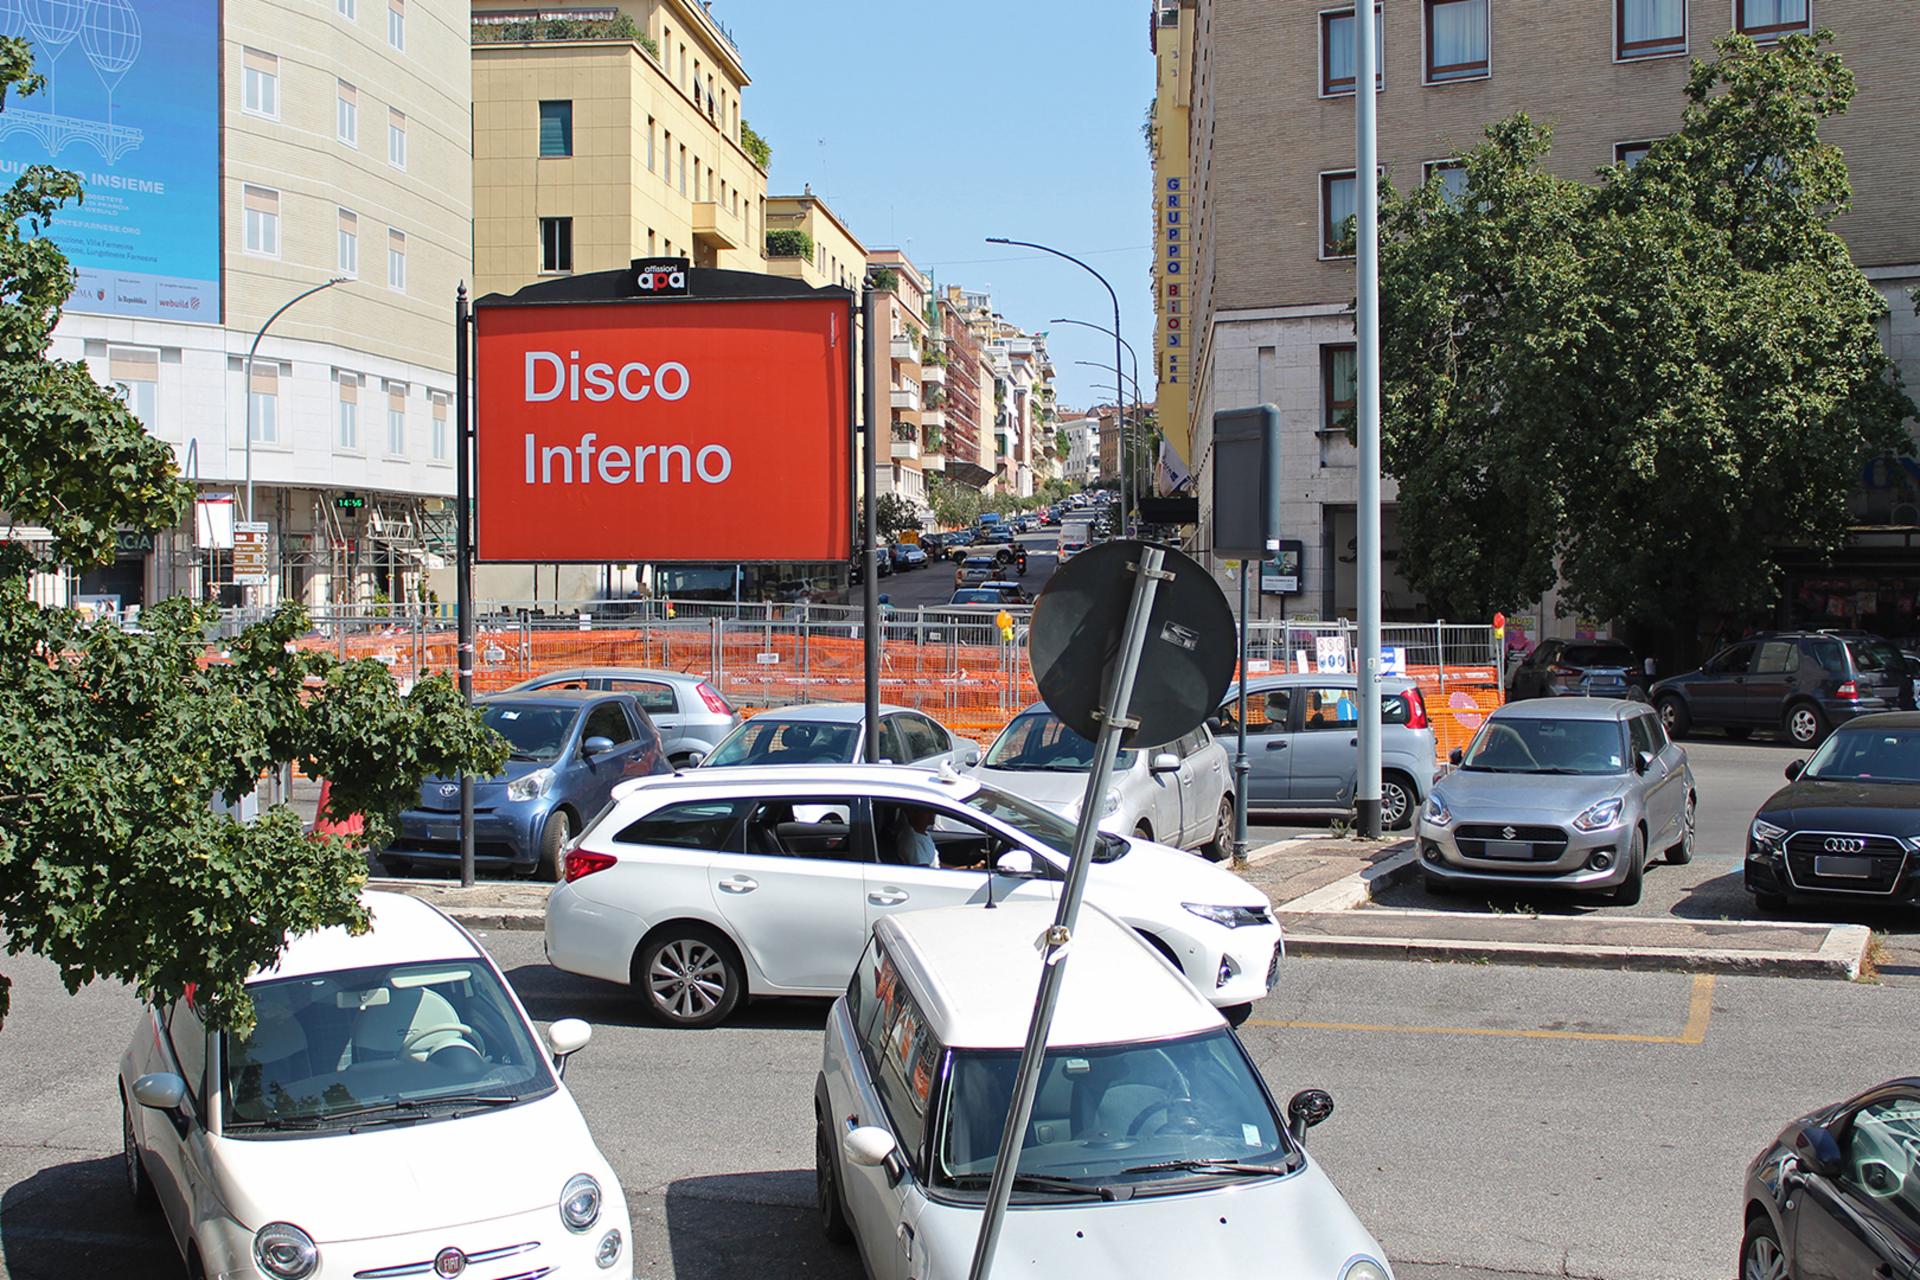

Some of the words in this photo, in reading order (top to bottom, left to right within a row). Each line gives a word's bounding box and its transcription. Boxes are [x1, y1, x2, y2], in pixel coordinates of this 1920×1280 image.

[91, 172, 165, 195] INSIEME
[1167, 178, 1180, 274] GRUPPO
[644, 264, 678, 273] affissioni
[637, 272, 685, 292] apa
[159, 298, 189, 309] webuild
[524, 351, 691, 403] Disco
[524, 433, 733, 484] Inferno
